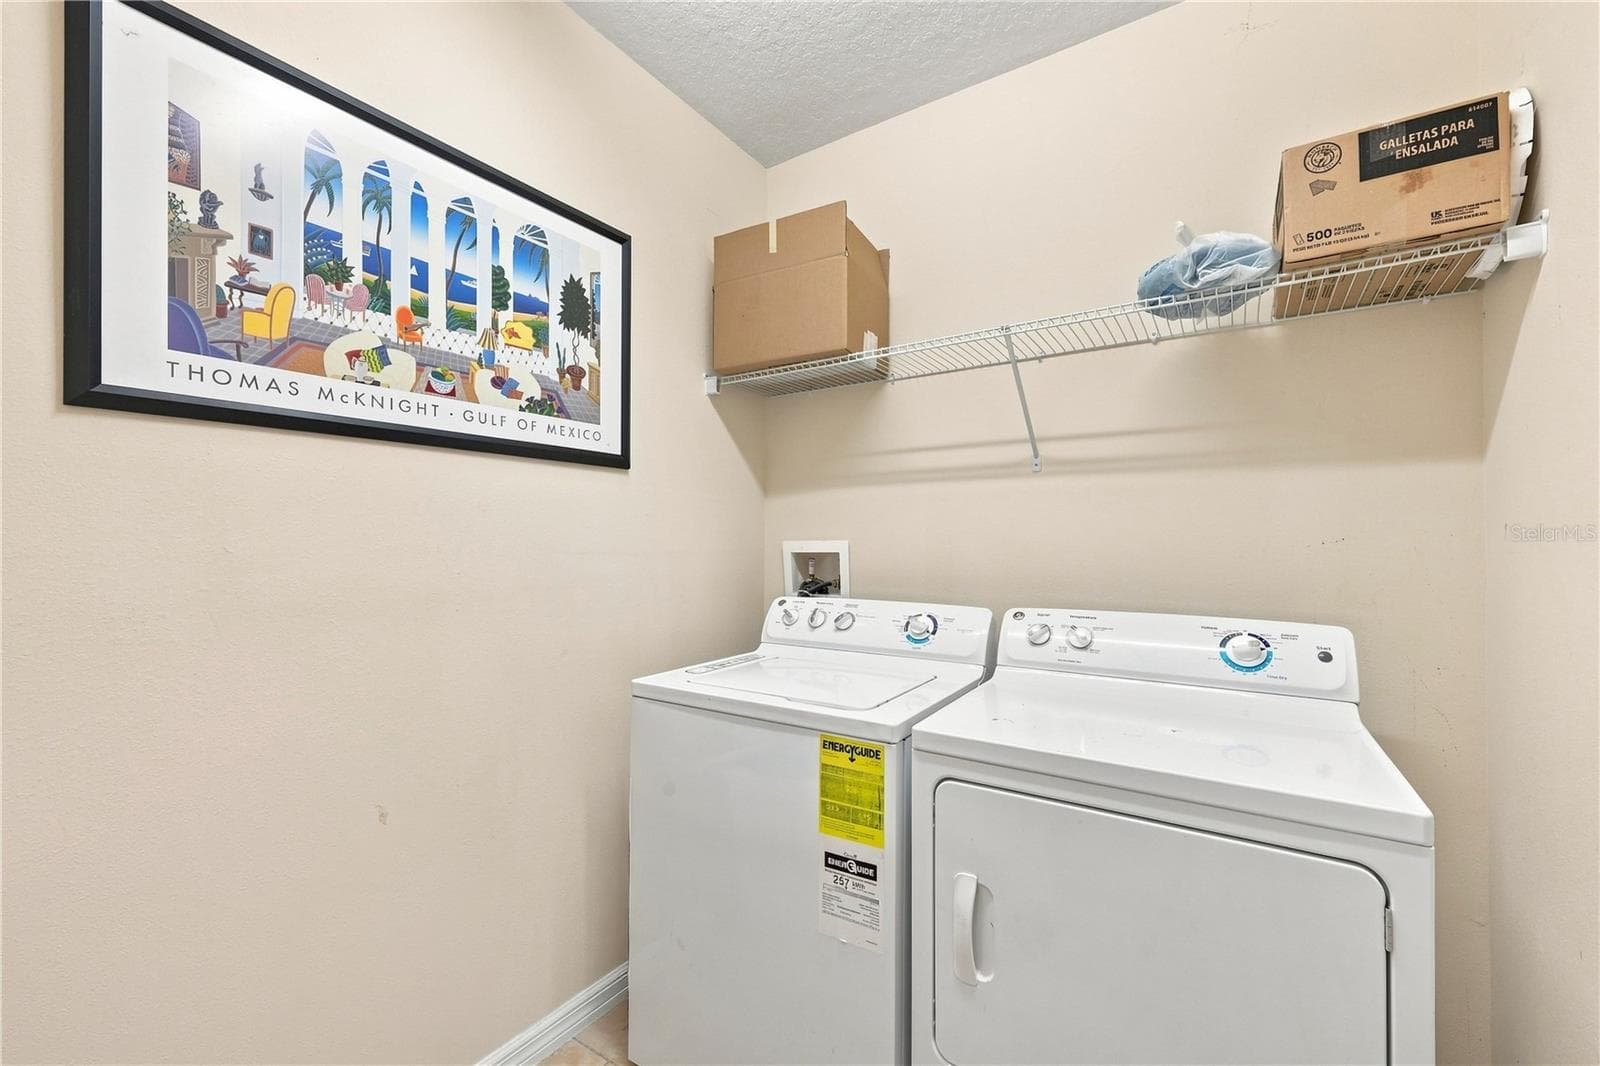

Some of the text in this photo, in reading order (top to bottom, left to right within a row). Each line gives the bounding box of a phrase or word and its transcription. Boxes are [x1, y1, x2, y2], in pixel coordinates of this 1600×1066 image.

[1380, 118, 1475, 151] GALLETAS PARA
[1395, 136, 1459, 160] ENSALADA
[1306, 228, 1332, 242] 500
[166, 361, 602, 442] THOMAS McKNIGHT GULF OF MEXICO
[823, 739, 882, 760] ENERGYGUIDE
[833, 874, 850, 887] 257
